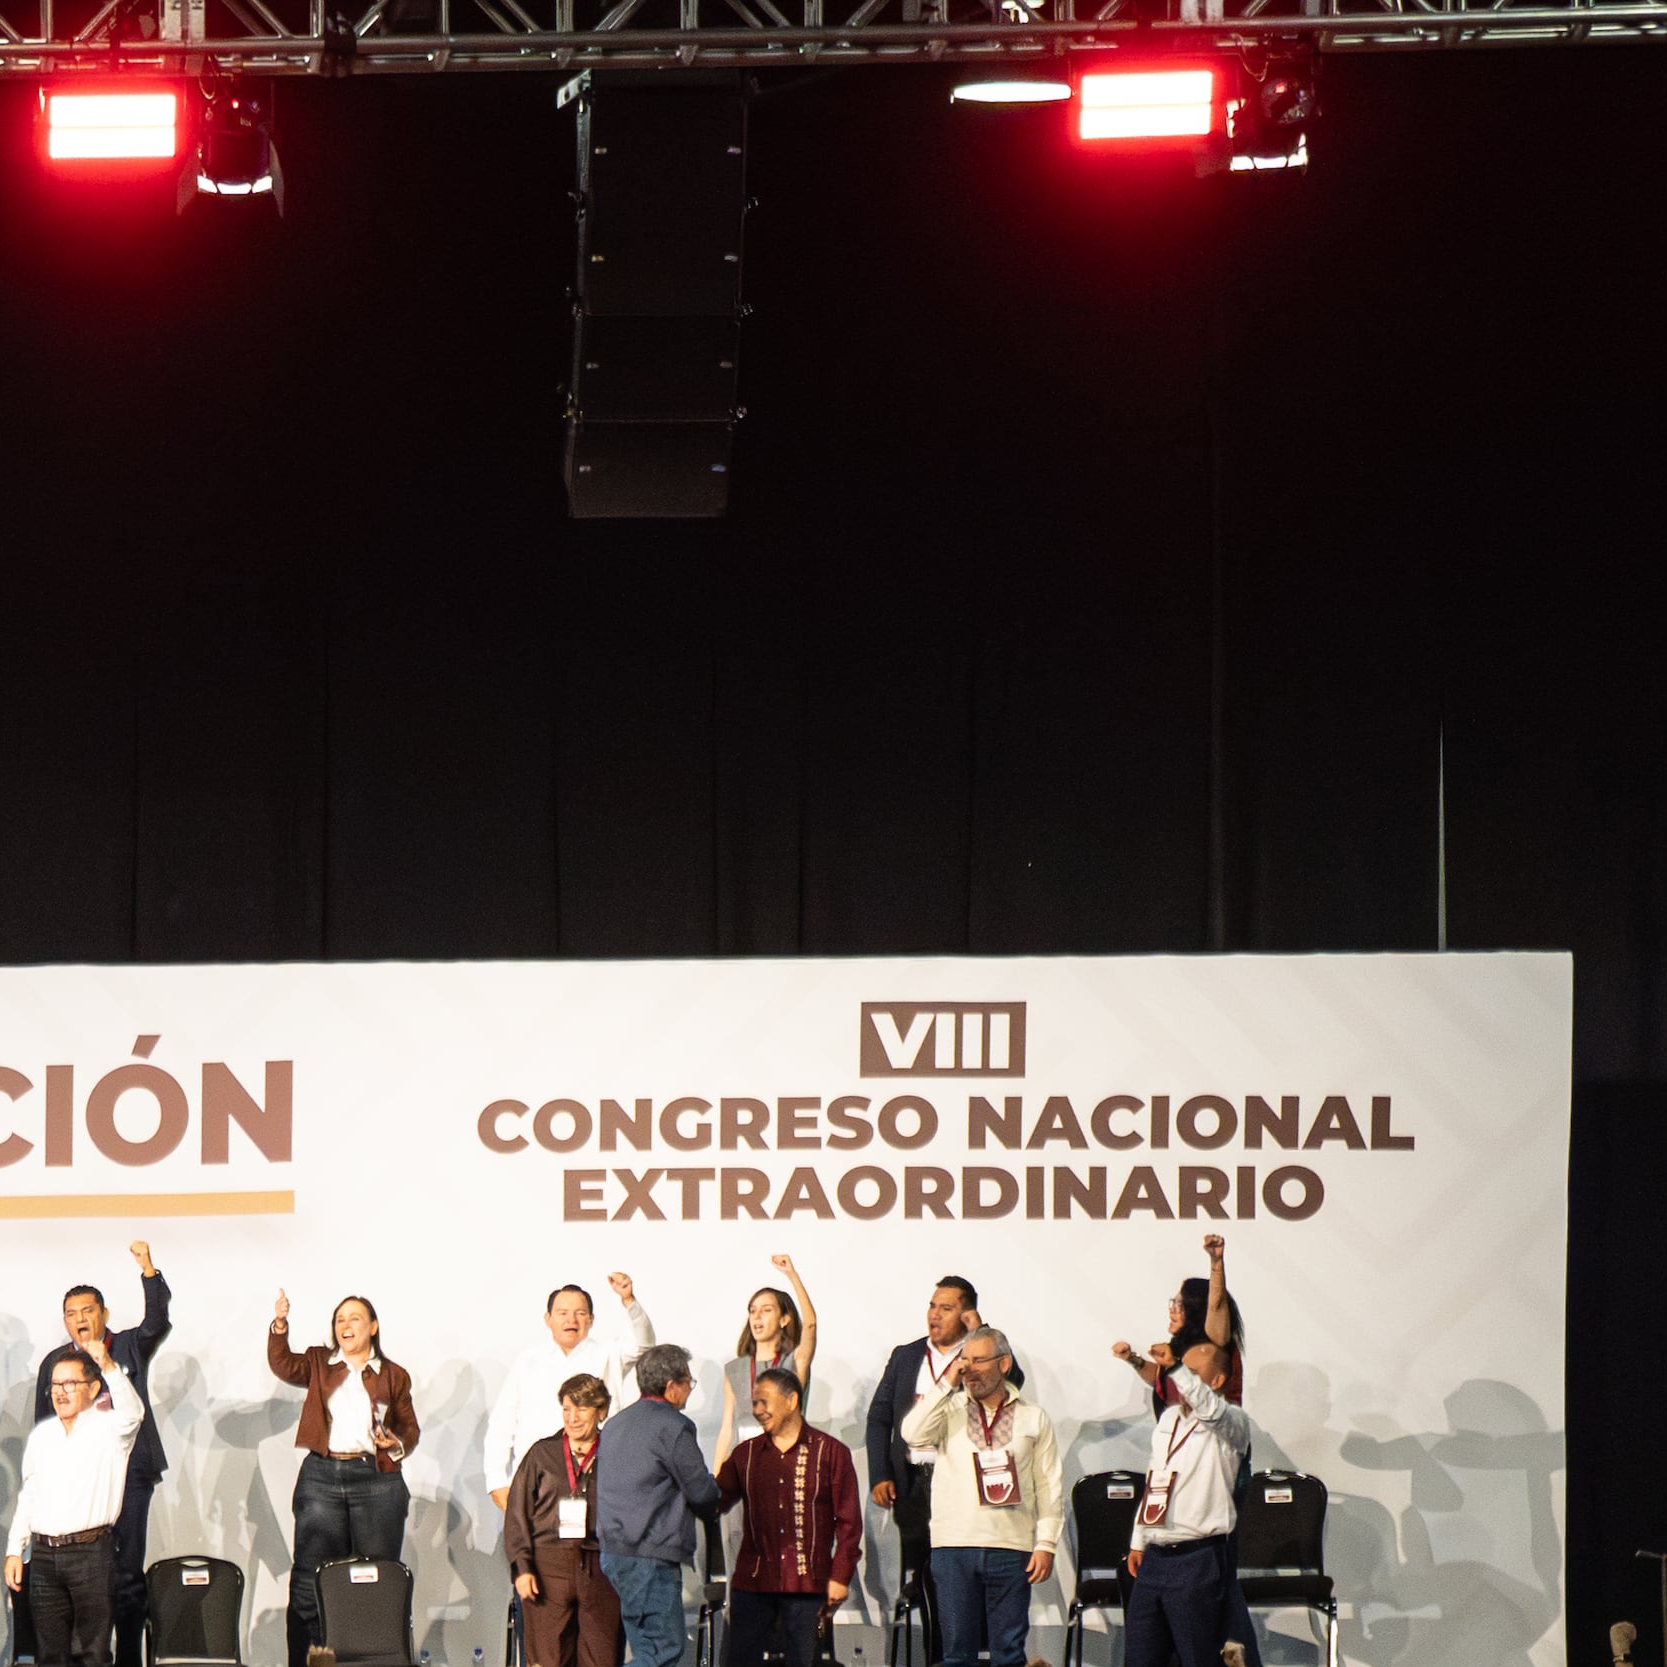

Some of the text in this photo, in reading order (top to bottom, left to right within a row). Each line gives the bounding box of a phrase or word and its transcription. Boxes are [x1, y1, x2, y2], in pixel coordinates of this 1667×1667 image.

[871, 1012, 1011, 1070] VIII
[477, 1095, 1415, 1153] CONGRESO NACIONAL
[563, 1165, 1325, 1222] EXTRAORDINARIO
